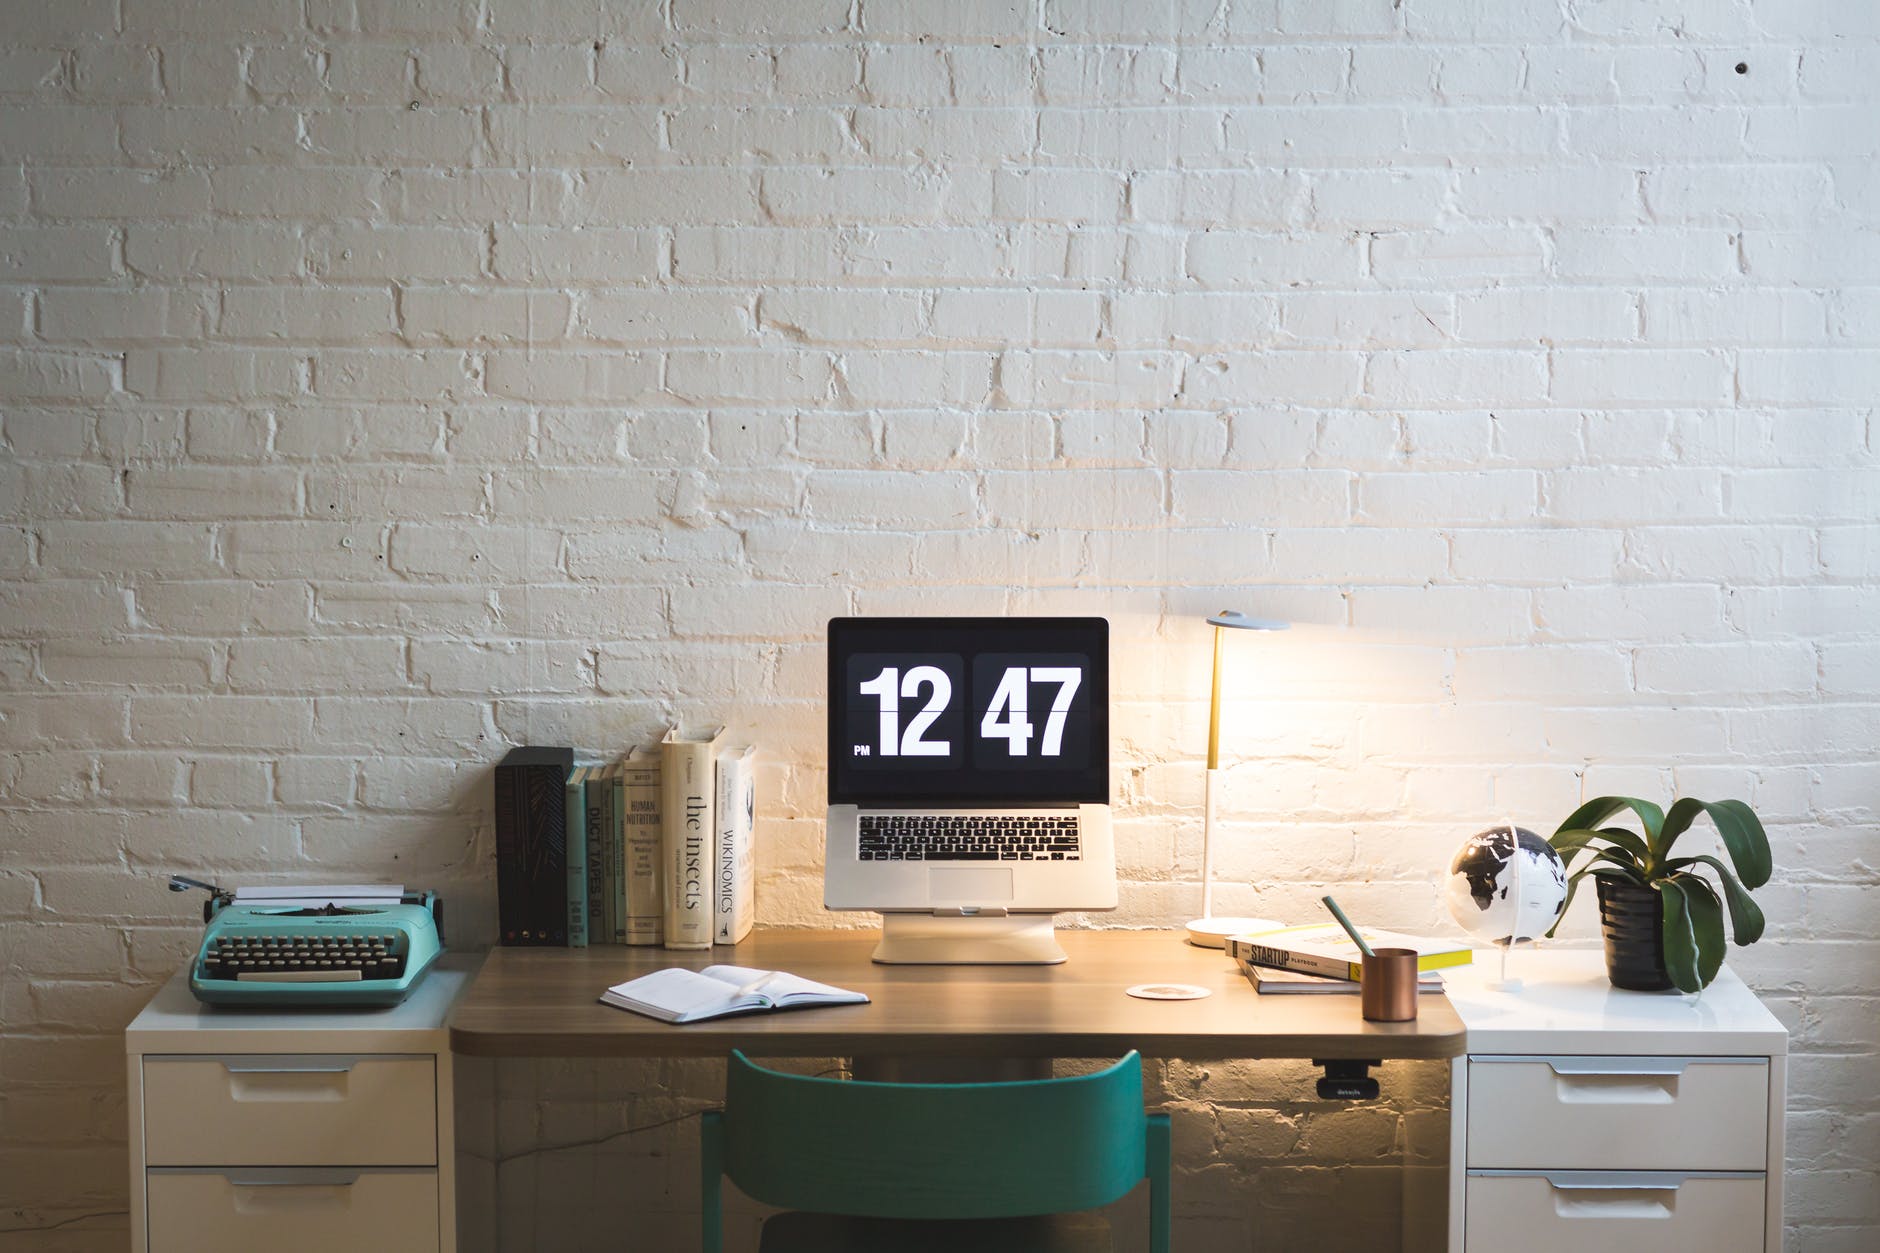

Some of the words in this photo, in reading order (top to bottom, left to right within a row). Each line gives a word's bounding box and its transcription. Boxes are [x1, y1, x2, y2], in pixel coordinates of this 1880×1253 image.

[860, 665, 952, 757] 12
[980, 666, 1082, 757] 47
[854, 745, 870, 756] PM
[626, 813, 660, 825] NUTRITION
[631, 800, 656, 812] HUMAN
[686, 795, 707, 830] the
[589, 807, 601, 843] DUCT
[589, 848, 601, 894] TAPES
[686, 836, 703, 910] insects
[721, 830, 733, 913] WIKINOMICS
[1251, 943, 1291, 967] STARTUP
